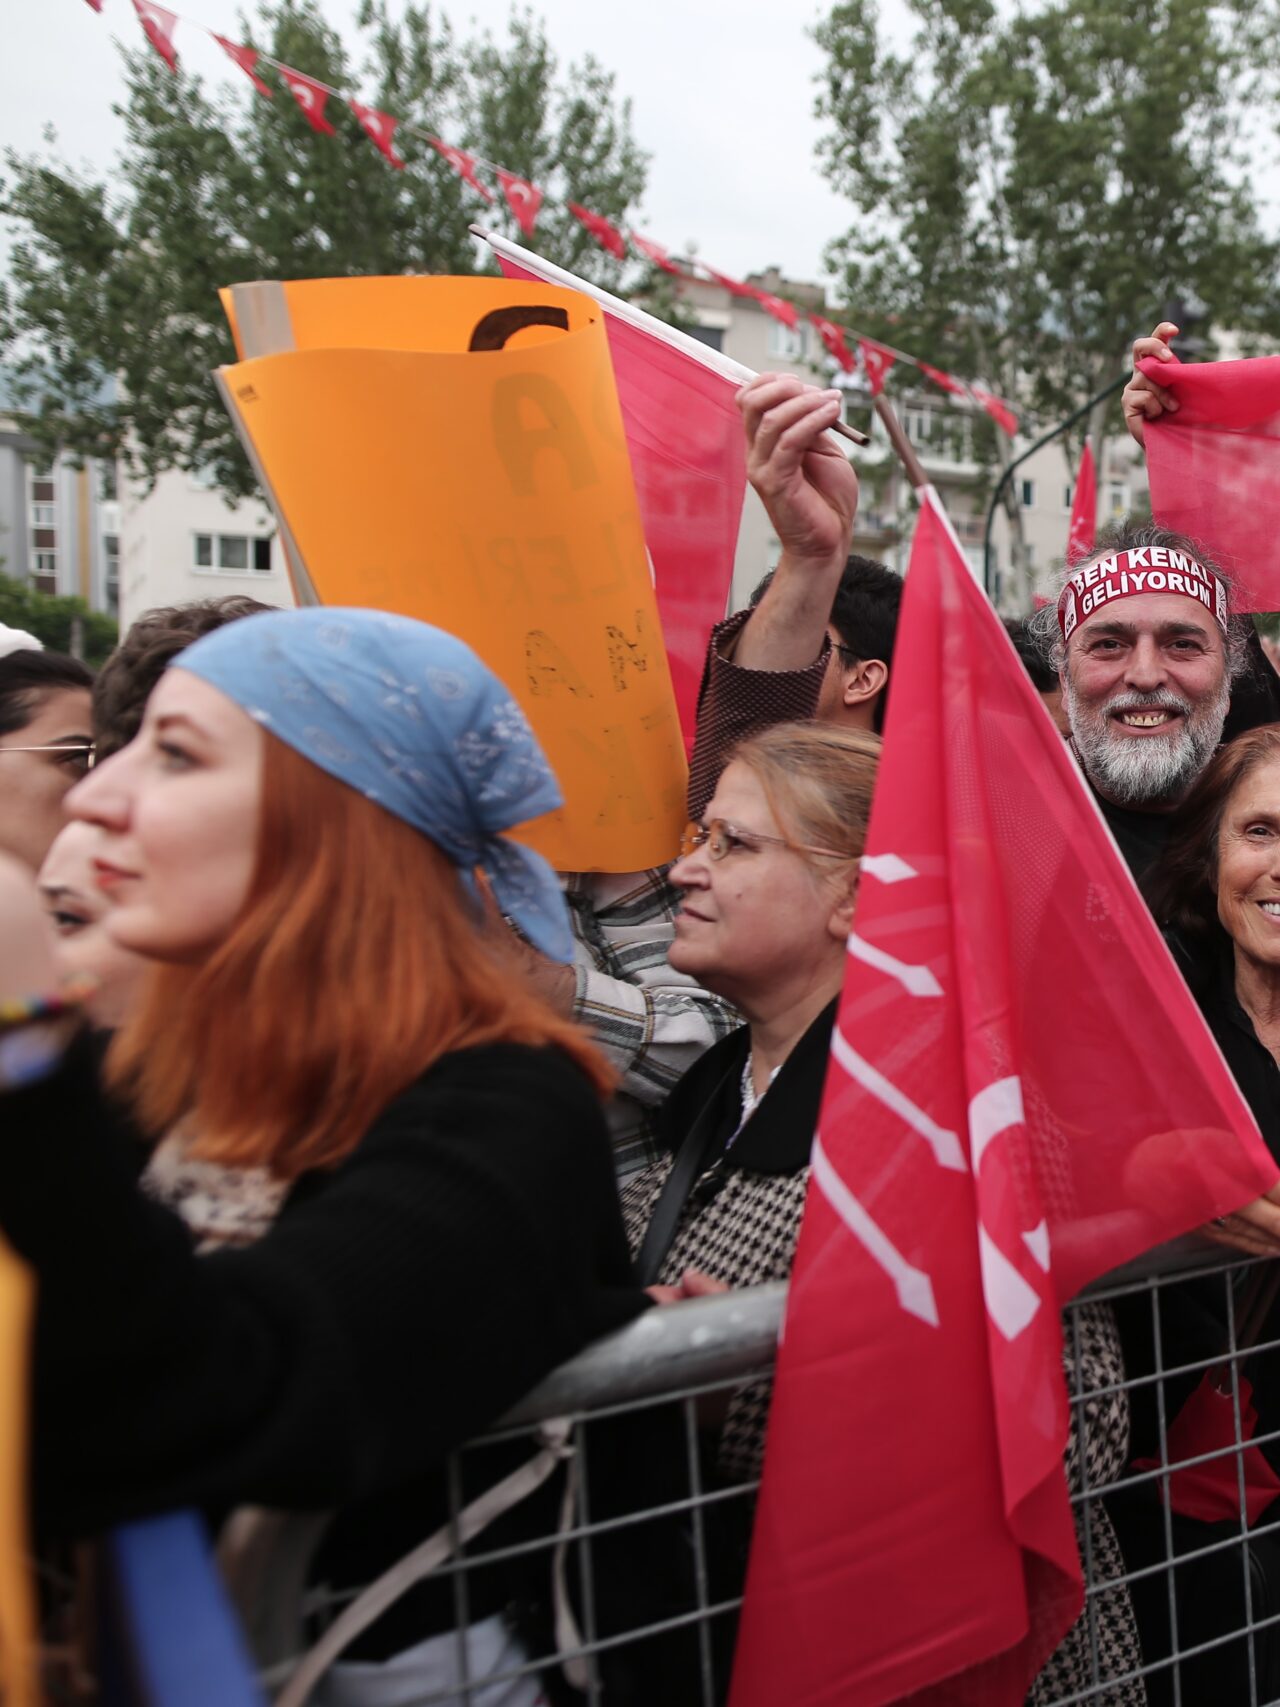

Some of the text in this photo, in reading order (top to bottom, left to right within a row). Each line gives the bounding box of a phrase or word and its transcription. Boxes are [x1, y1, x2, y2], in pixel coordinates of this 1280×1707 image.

[1074, 548, 1213, 598] BEN KEMAL
[1082, 570, 1212, 615] GELİYORUM
